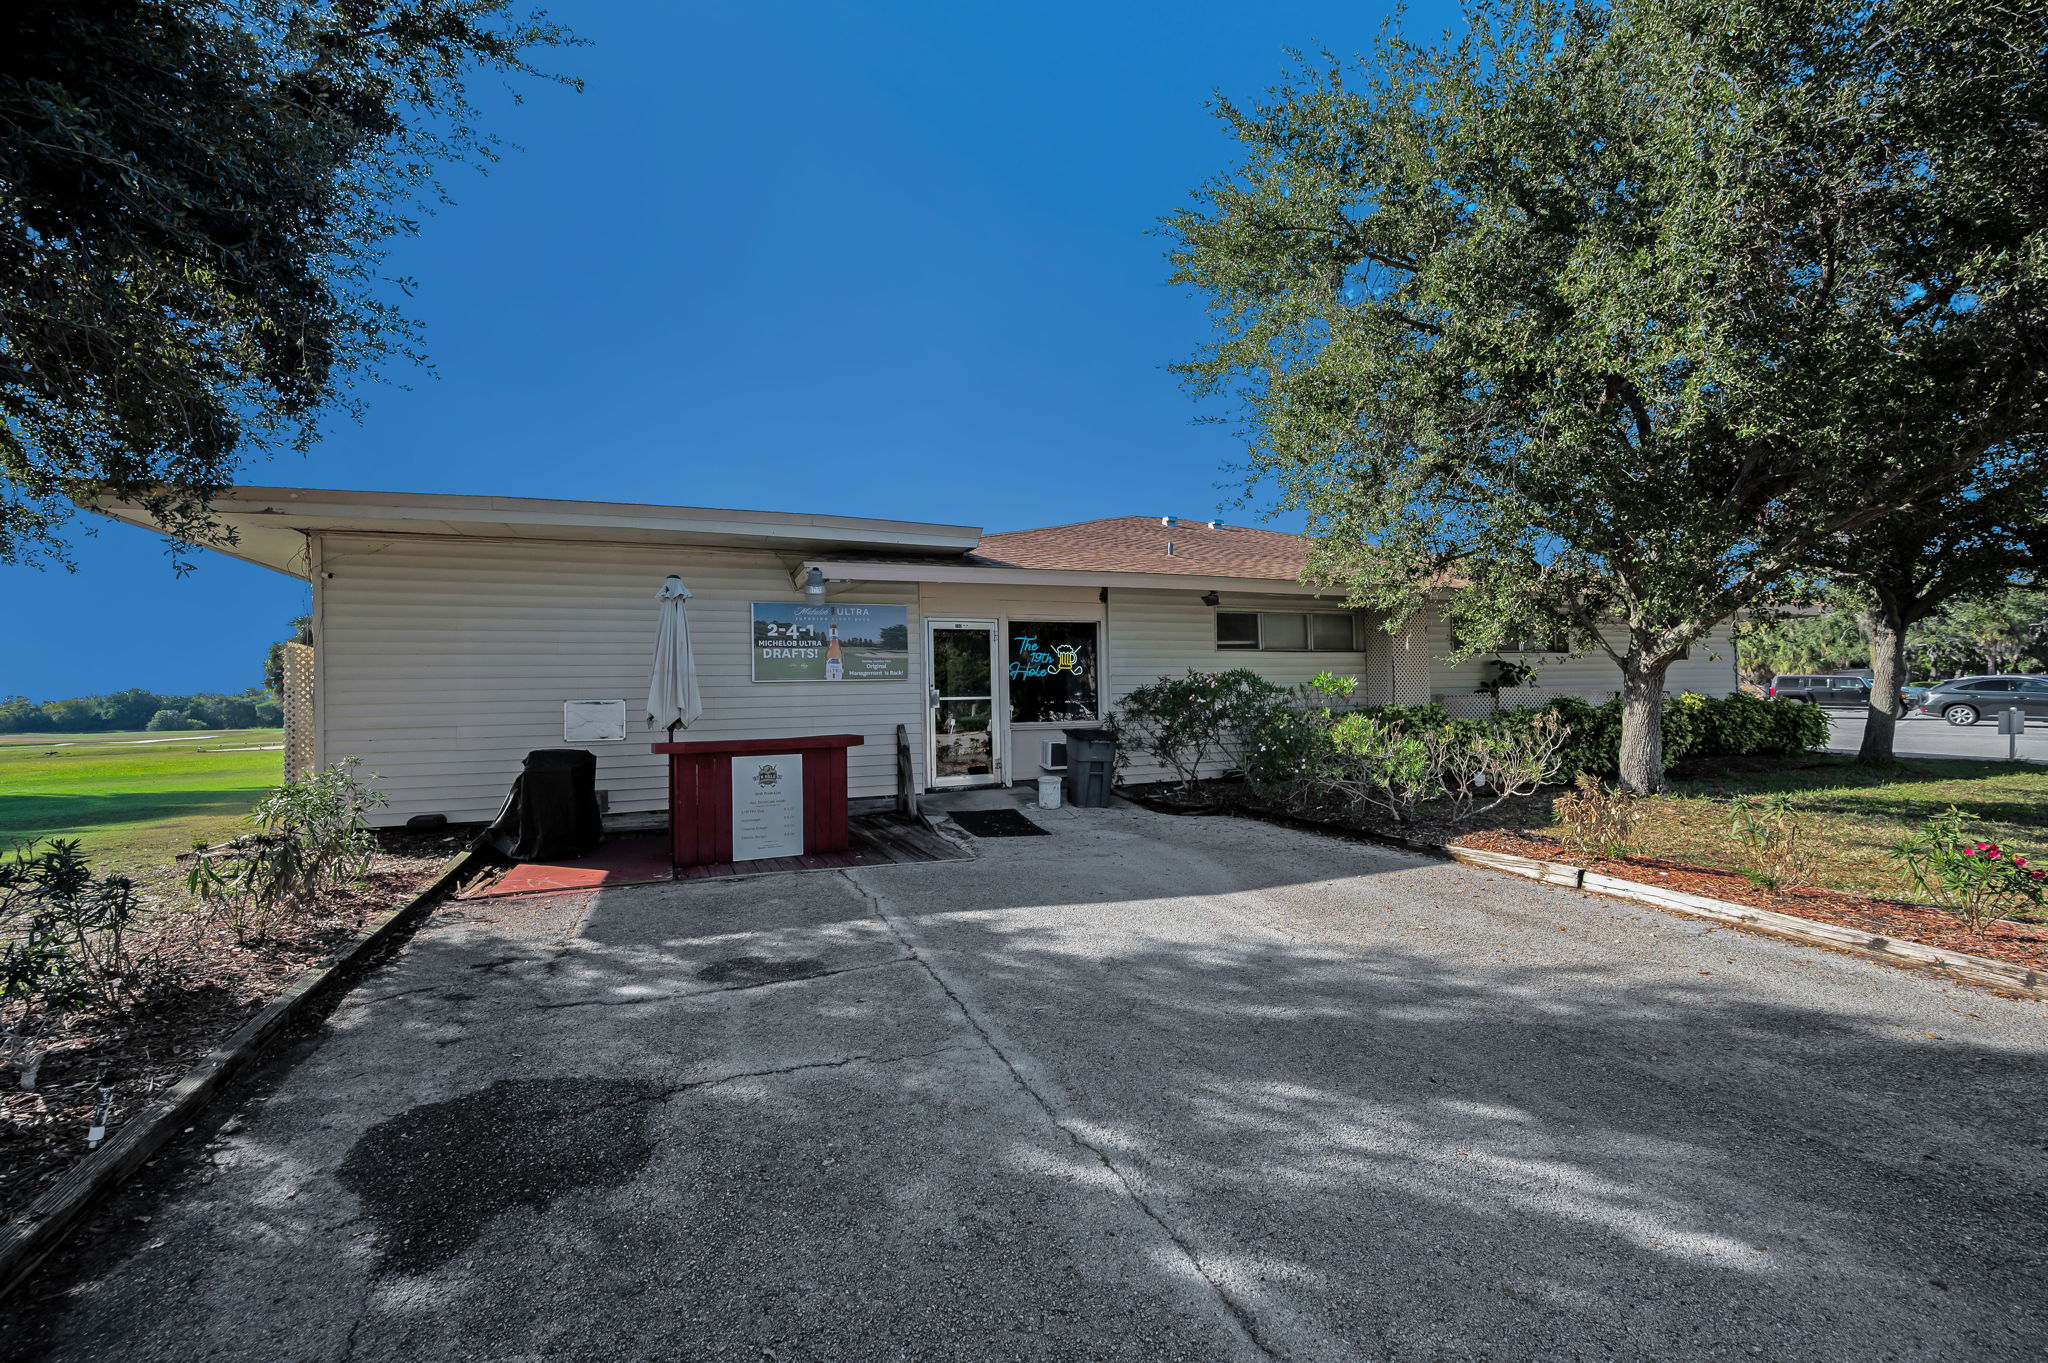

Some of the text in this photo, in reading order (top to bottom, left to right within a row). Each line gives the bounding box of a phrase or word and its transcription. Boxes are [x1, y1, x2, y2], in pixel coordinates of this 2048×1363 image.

[836, 608, 870, 616] ULTRA
[767, 623, 814, 640] 2-4-1
[1013, 635, 1040, 655] The
[763, 648, 819, 659] DRAFTS!
[1030, 652, 1054, 663] 19th
[866, 663, 887, 671] Original
[1009, 662, 1047, 680] Hole
